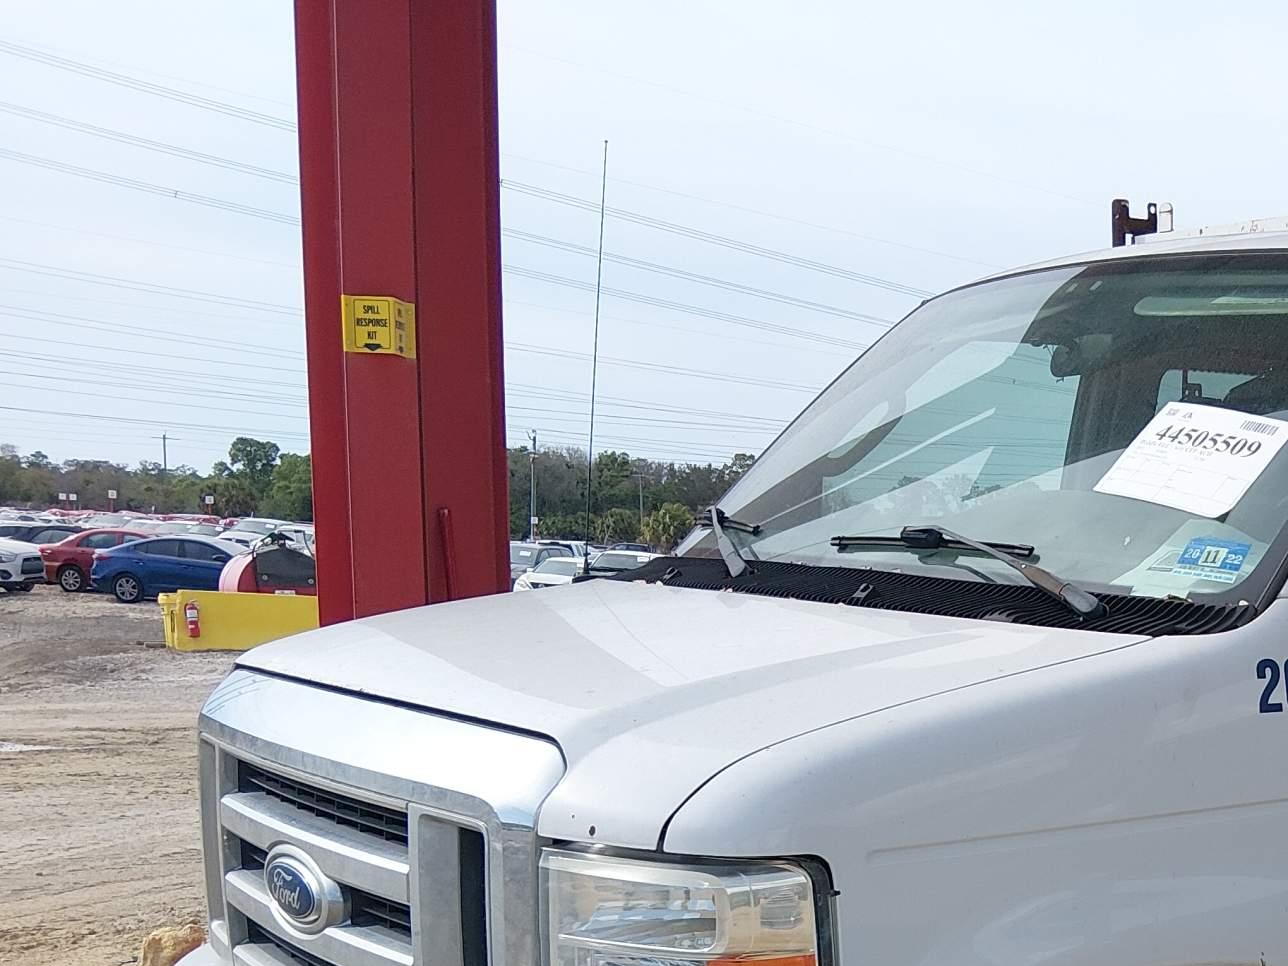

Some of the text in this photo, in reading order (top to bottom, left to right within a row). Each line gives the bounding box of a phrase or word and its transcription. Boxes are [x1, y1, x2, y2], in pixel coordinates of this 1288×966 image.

[362, 305, 380, 315] SPILL
[356, 318, 388, 328] RESPONSE
[367, 331, 377, 340] KIT
[1155, 425, 1262, 458] 44505509
[271, 868, 300, 909] Ford
